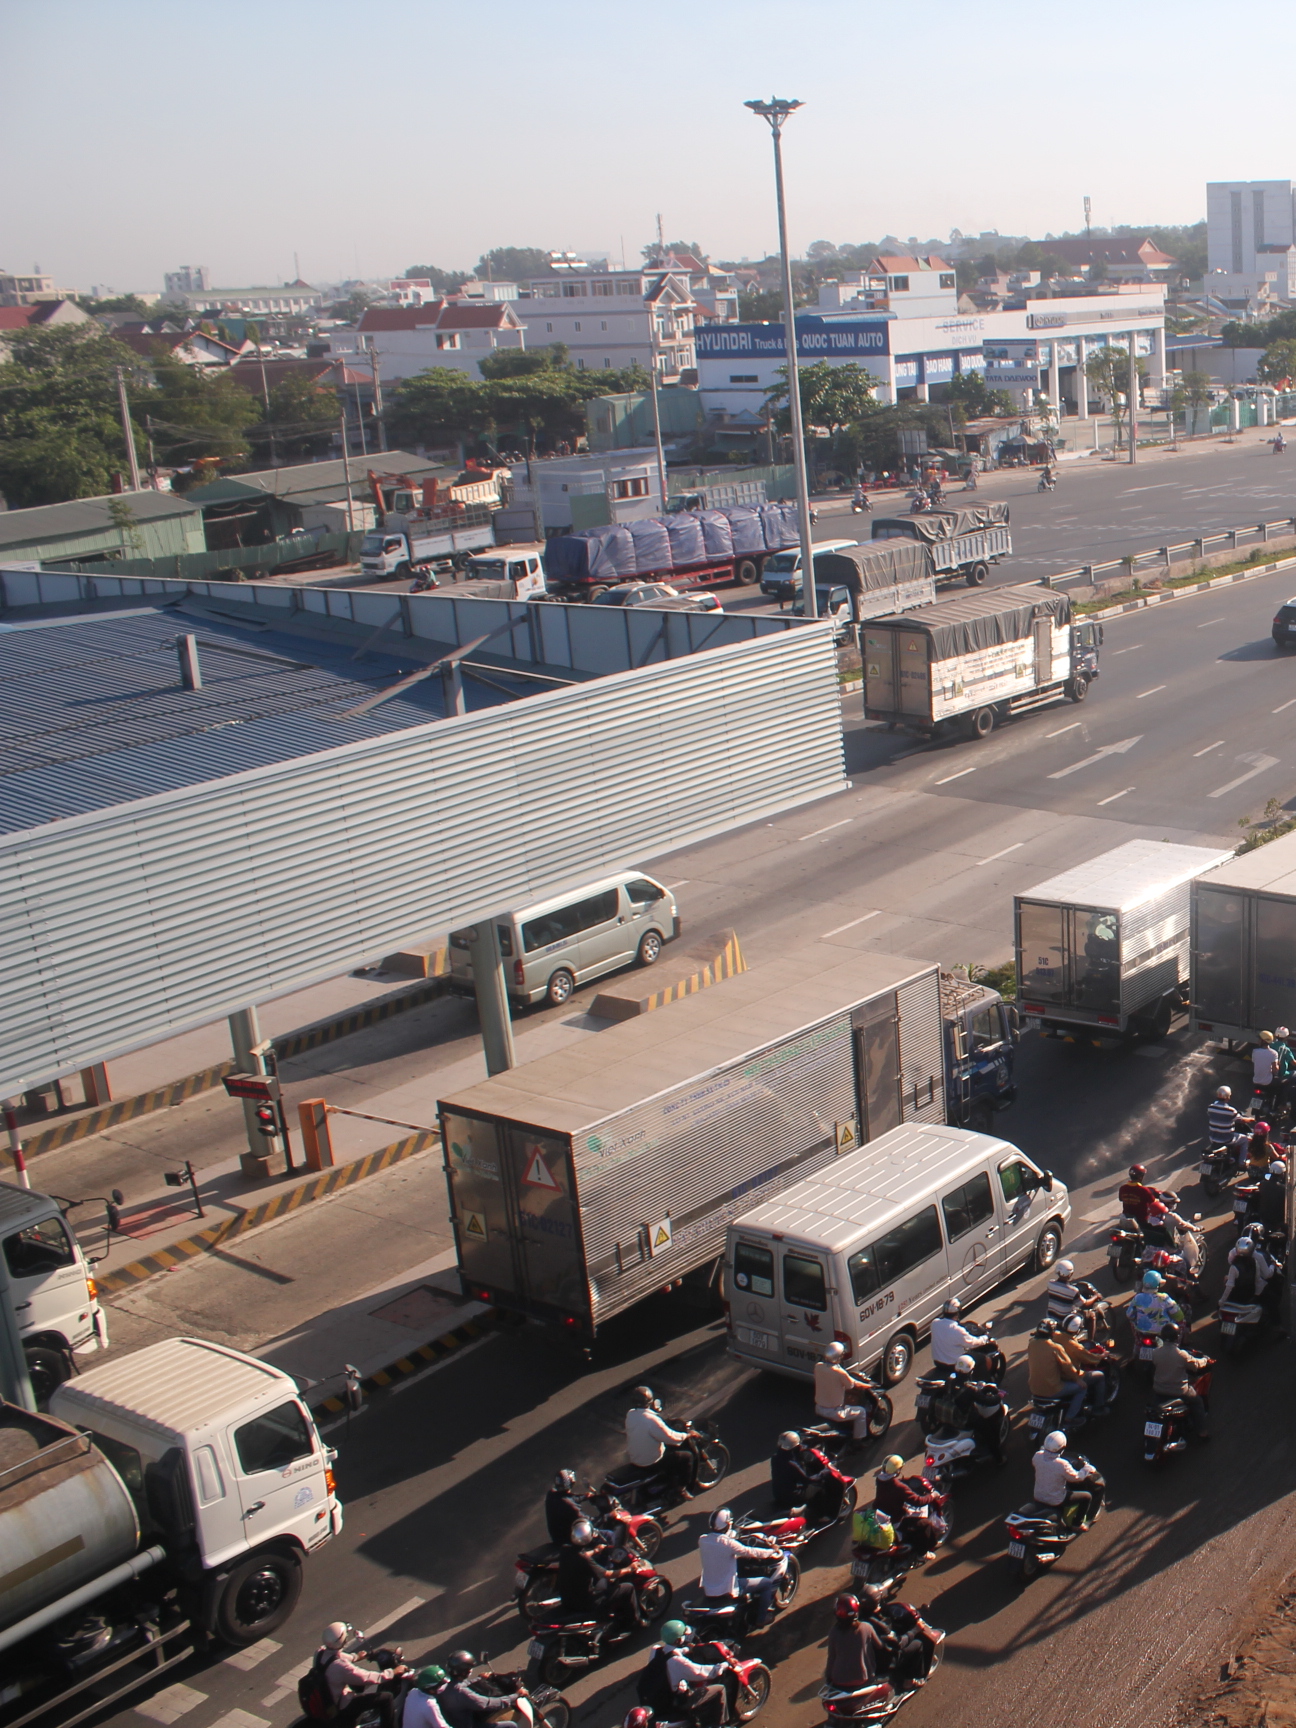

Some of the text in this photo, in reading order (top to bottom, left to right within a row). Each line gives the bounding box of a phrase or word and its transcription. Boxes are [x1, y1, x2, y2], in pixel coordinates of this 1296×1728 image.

[942, 319, 985, 333] SERVICE
[696, 333, 751, 350] HYUNDAI
[754, 338, 776, 350] Truck
[858, 332, 883, 347] AUTO
[1038, 957, 1049, 966] 51C
[476, 1159, 497, 1172] Xanh
[786, 1346, 823, 1361] 60V-18-7
[294, 1459, 319, 1474] HINO
